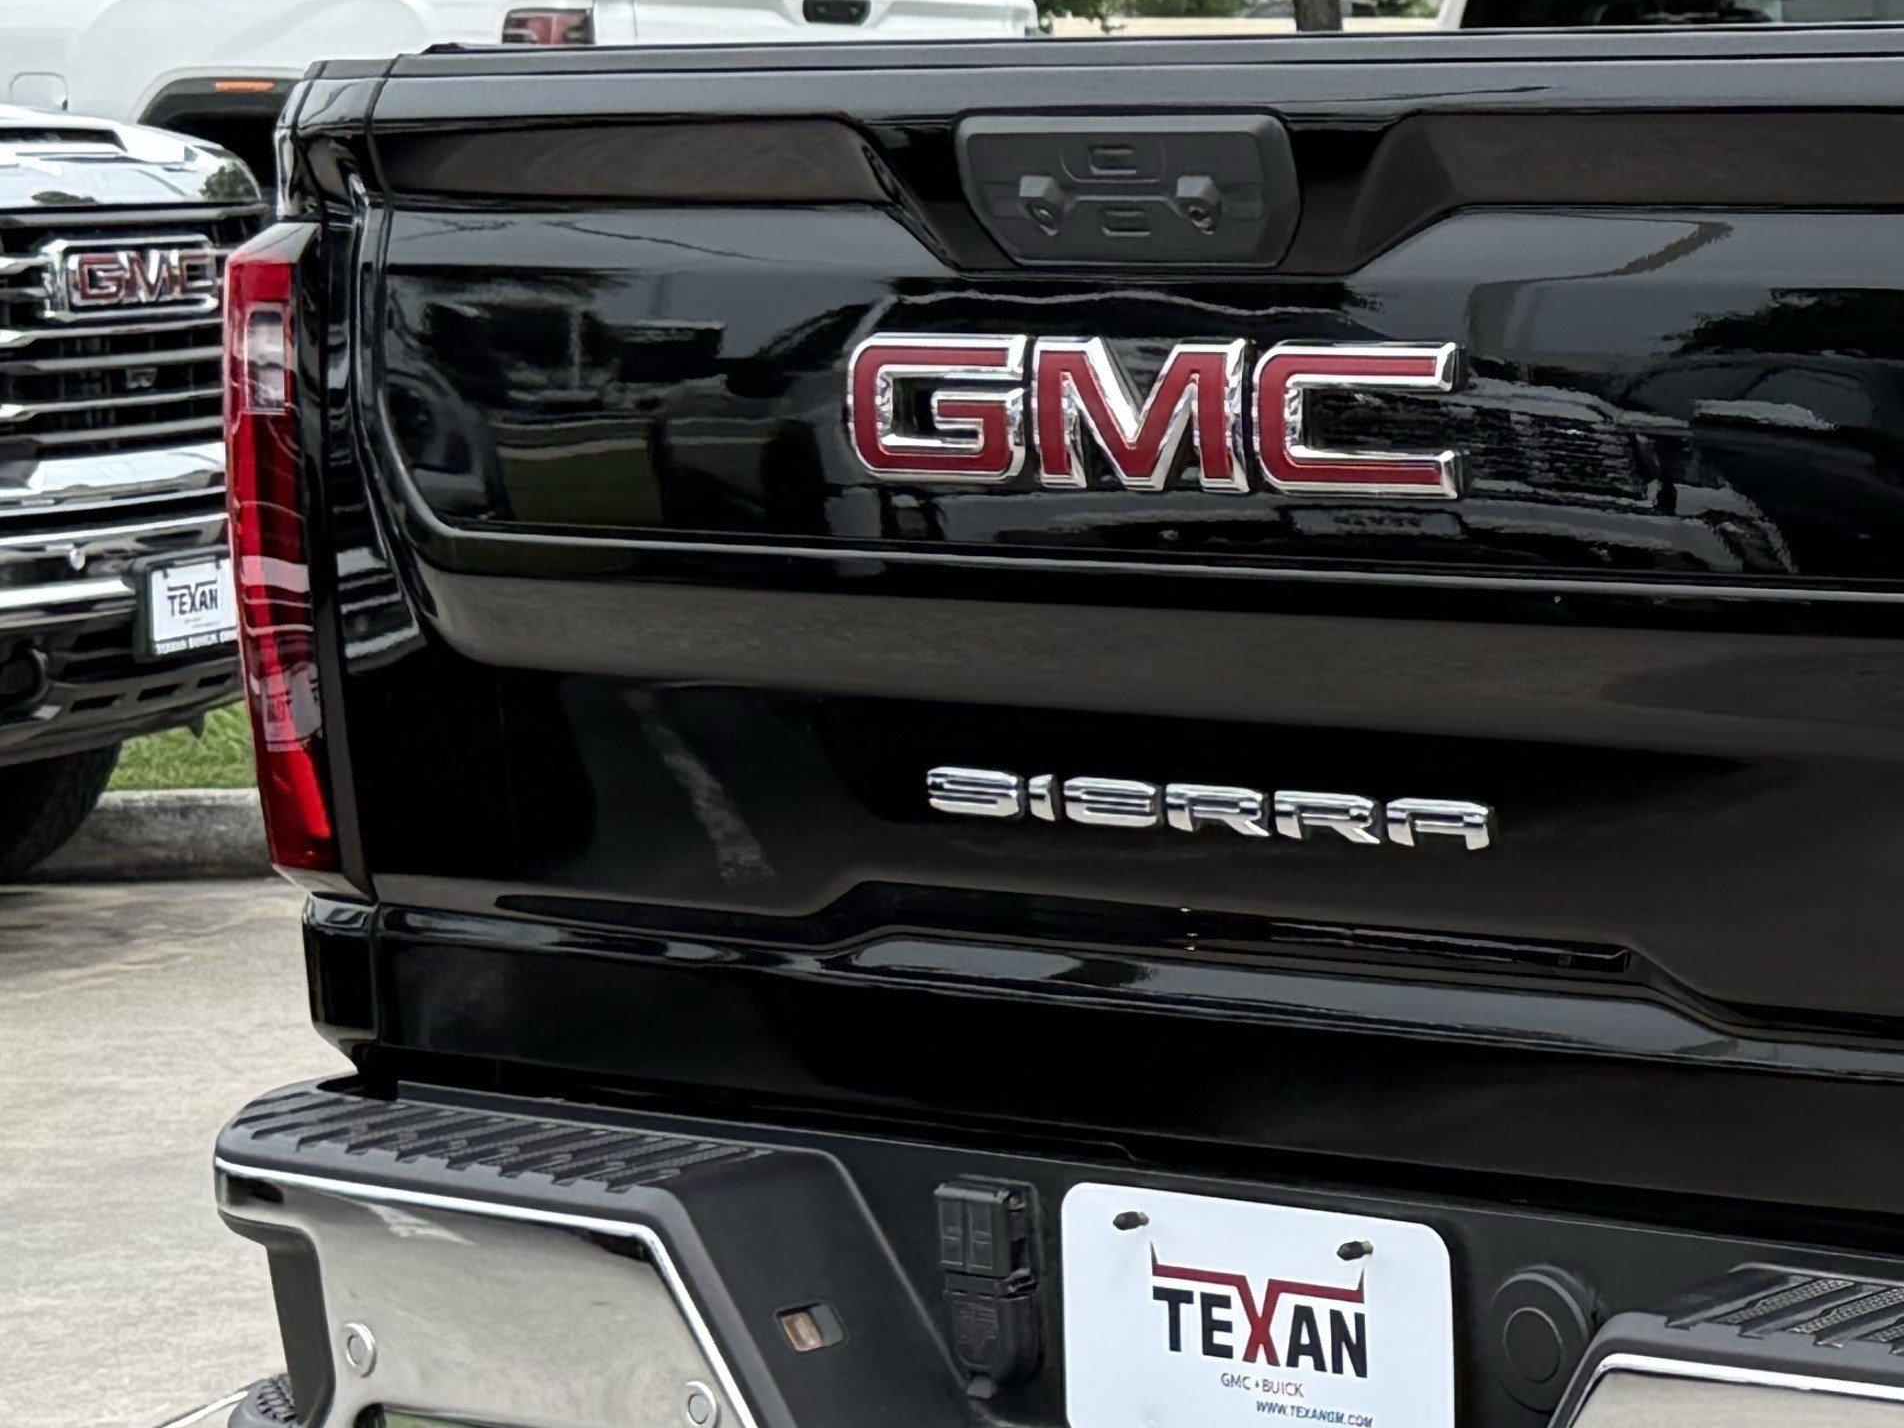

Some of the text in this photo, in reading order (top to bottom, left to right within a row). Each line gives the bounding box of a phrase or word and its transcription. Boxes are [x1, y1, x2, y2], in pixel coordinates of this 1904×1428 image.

[67, 248, 217, 306] GMC
[848, 333, 1463, 499] GMC
[166, 581, 219, 617] TEXAN
[926, 766, 1497, 850] SIERRA
[1151, 1264, 1368, 1379] TEXAN
[1220, 1372, 1305, 1399] GMC BUICK
[1256, 1400, 1374, 1428] WWW.TEXANGM.COM
